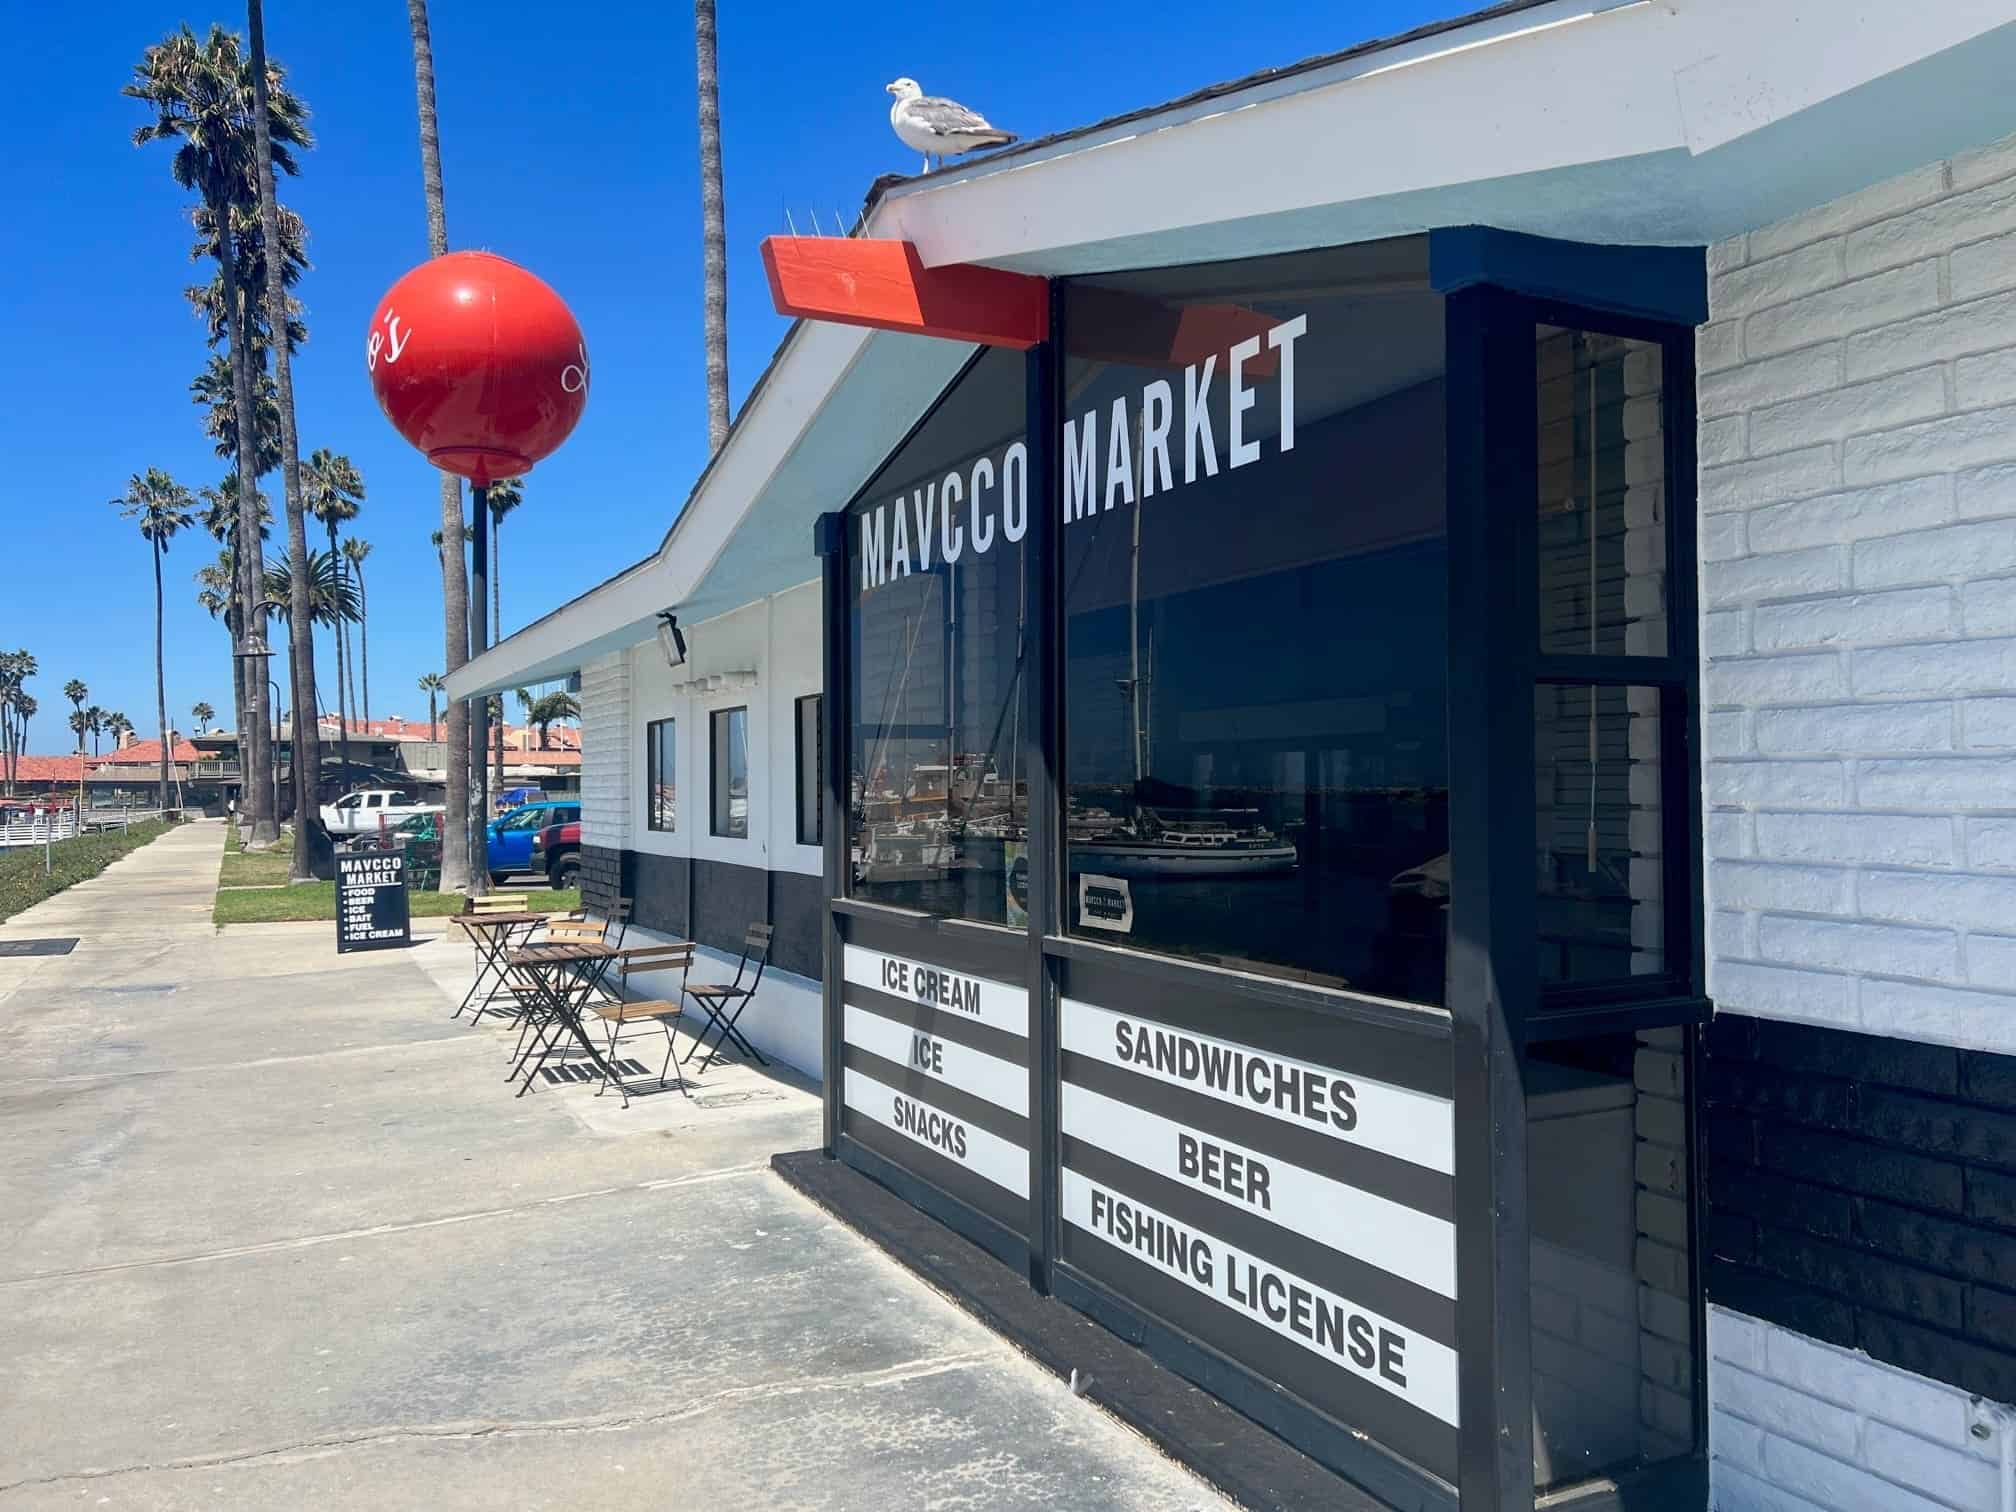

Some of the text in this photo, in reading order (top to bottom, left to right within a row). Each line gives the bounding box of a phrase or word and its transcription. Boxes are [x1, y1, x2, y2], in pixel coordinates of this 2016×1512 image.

[861, 314, 1307, 591] MAVCCO MARKET
[341, 857, 401, 872] MAVCCO
[346, 871, 397, 885] MARKET
[348, 888, 375, 896] FOOD
[348, 897, 374, 905] BEER
[349, 906, 366, 914] ICE
[349, 914, 372, 923] BAIT
[350, 923, 374, 931] FUEL
[350, 929, 403, 940] ICE CREAM
[882, 958, 981, 1016] ICE CREAM
[914, 1035, 943, 1074] ICE
[1115, 1020, 1358, 1132] SANDWICHES
[894, 1096, 966, 1159] SNACKS
[1178, 1132, 1271, 1211] BEER
[1090, 1189, 1407, 1390] FISHING LICENSE
